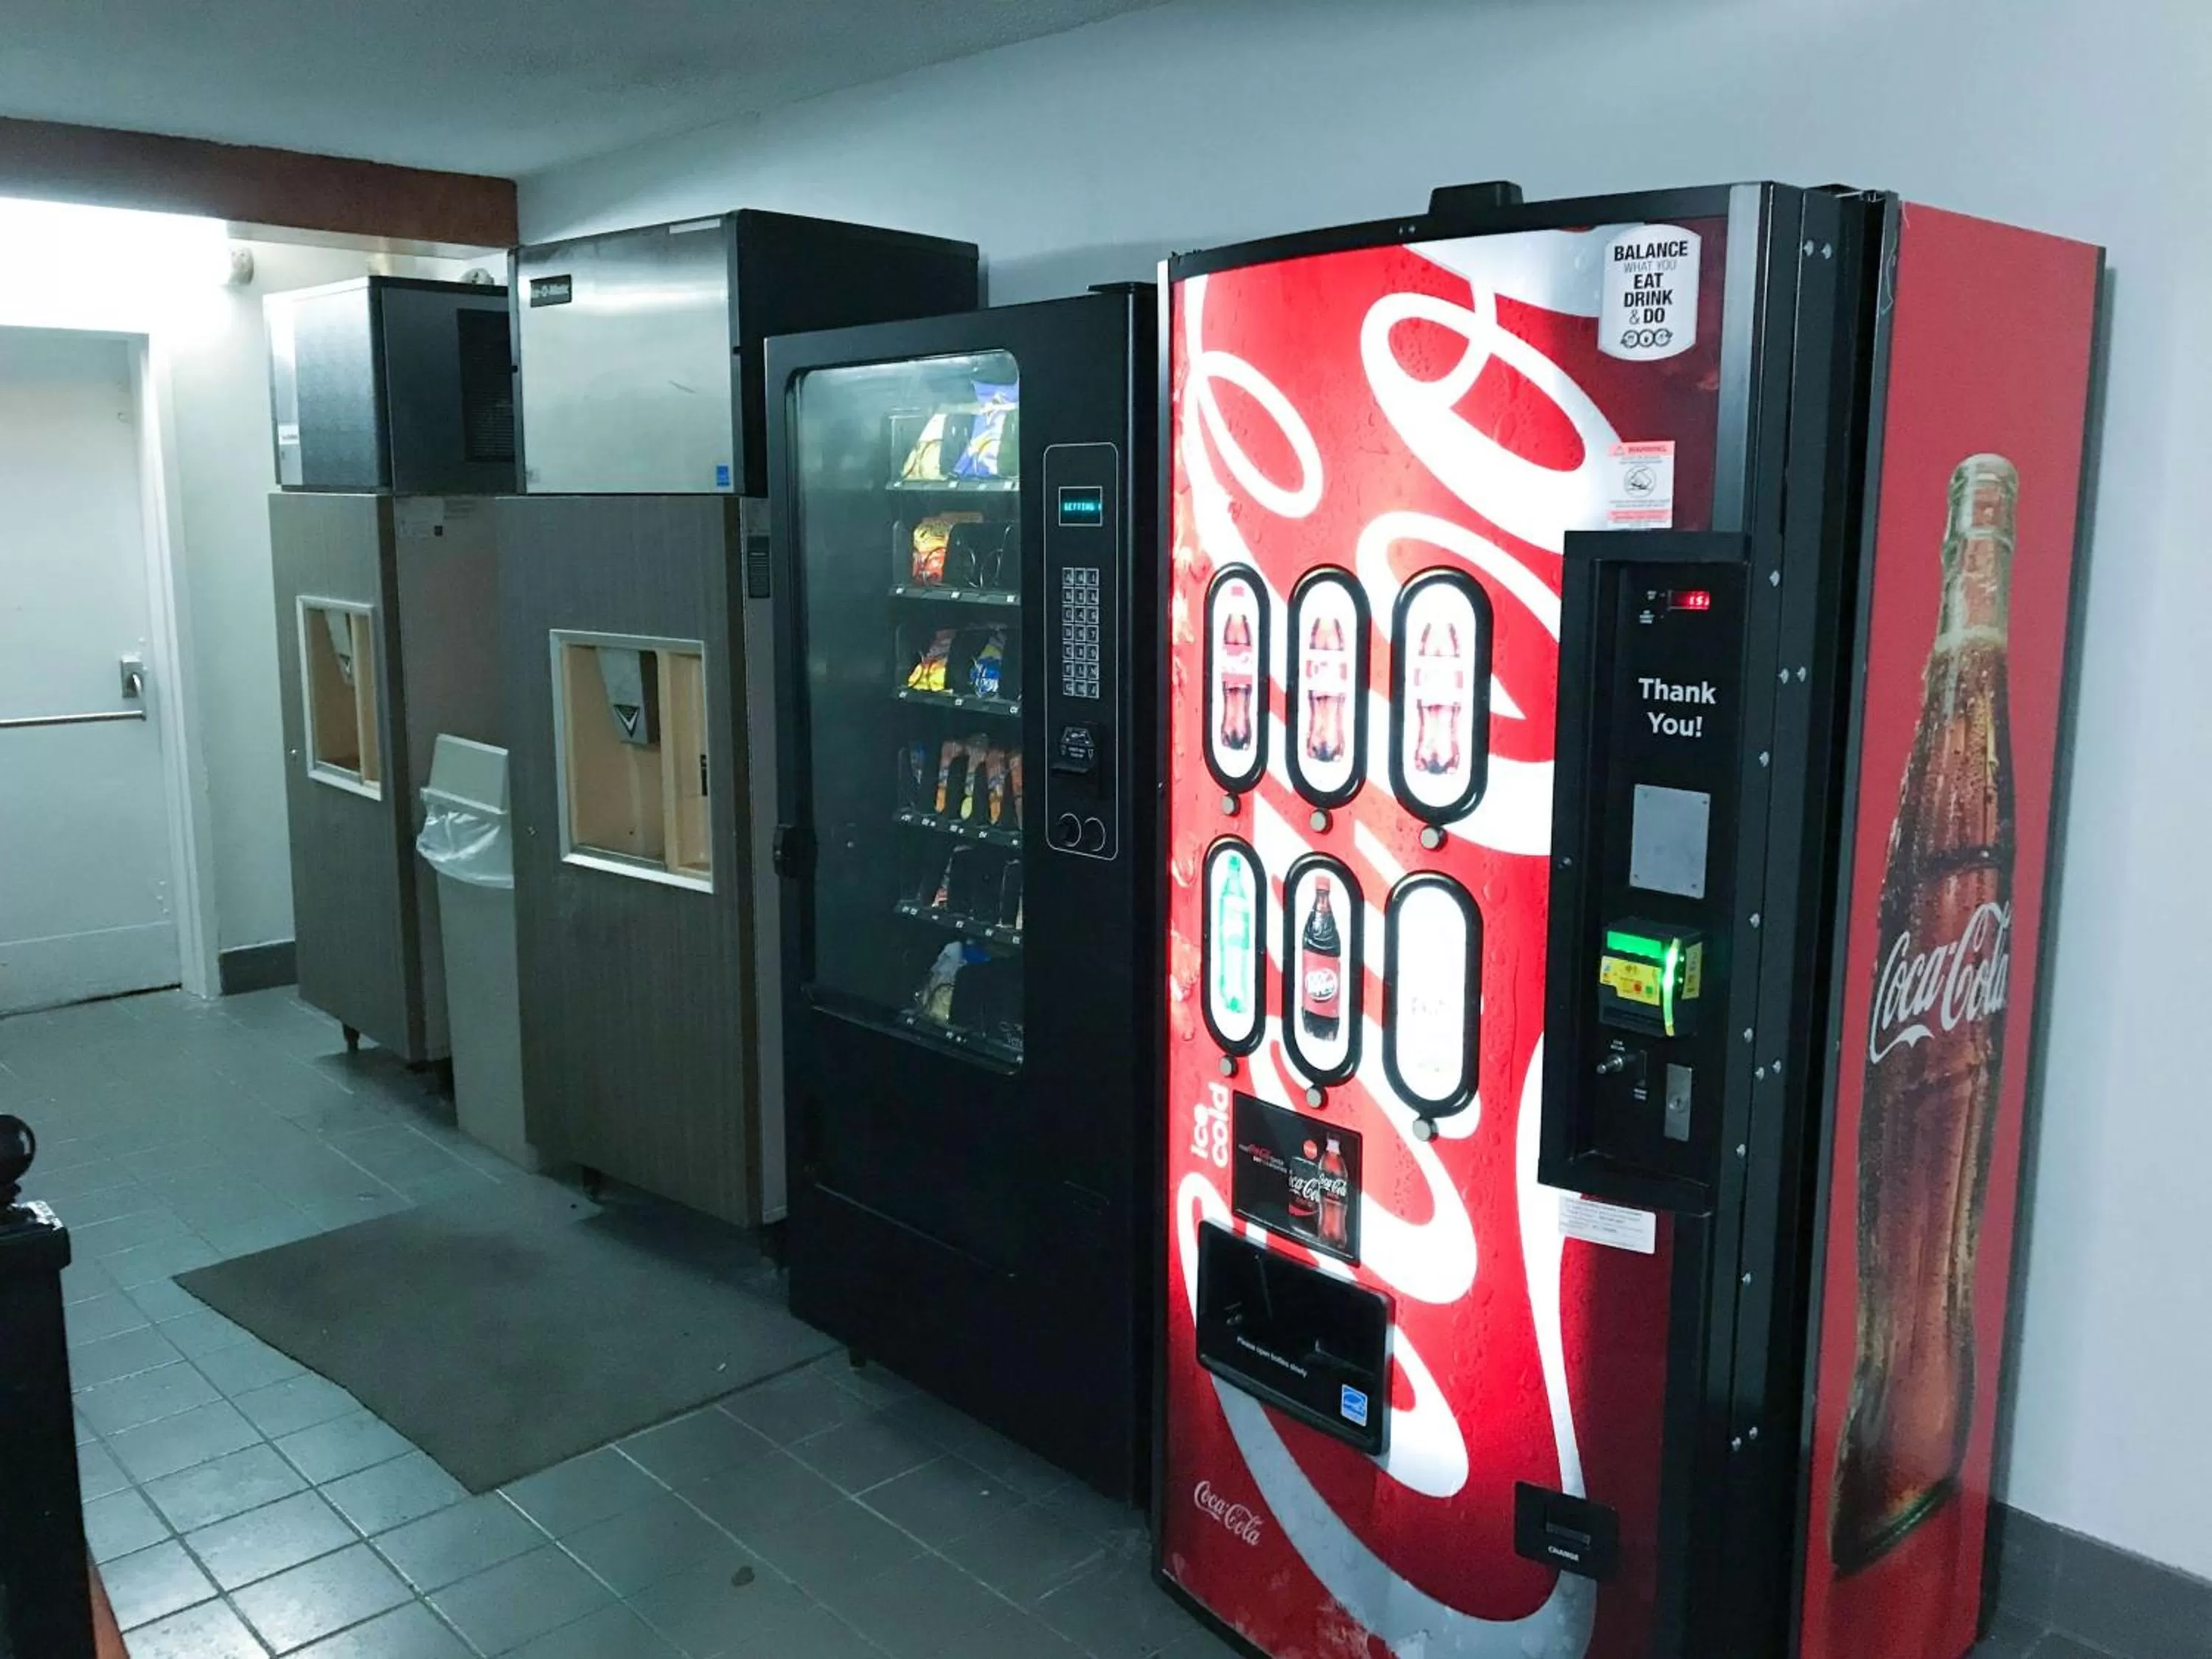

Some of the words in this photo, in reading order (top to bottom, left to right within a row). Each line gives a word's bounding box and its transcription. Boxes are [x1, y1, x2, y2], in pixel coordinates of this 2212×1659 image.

[1614, 240, 1688, 261] BALANCE
[1624, 260, 1652, 273] WHAT
[1657, 259, 1677, 271] YOU
[1633, 272, 1664, 289] EAT
[1623, 289, 1674, 307] DRINK
[1629, 308, 1641, 325] &
[1643, 307, 1666, 324] DO
[1638, 677, 1717, 705] Thank
[1647, 712, 1703, 738] You!
[1869, 900, 2011, 1064] Coca-Cola
[1208, 1080, 1229, 1169] cold
[1194, 1480, 1265, 1546] Coca-Cola
[1548, 1545, 1579, 1562] CHANGE
